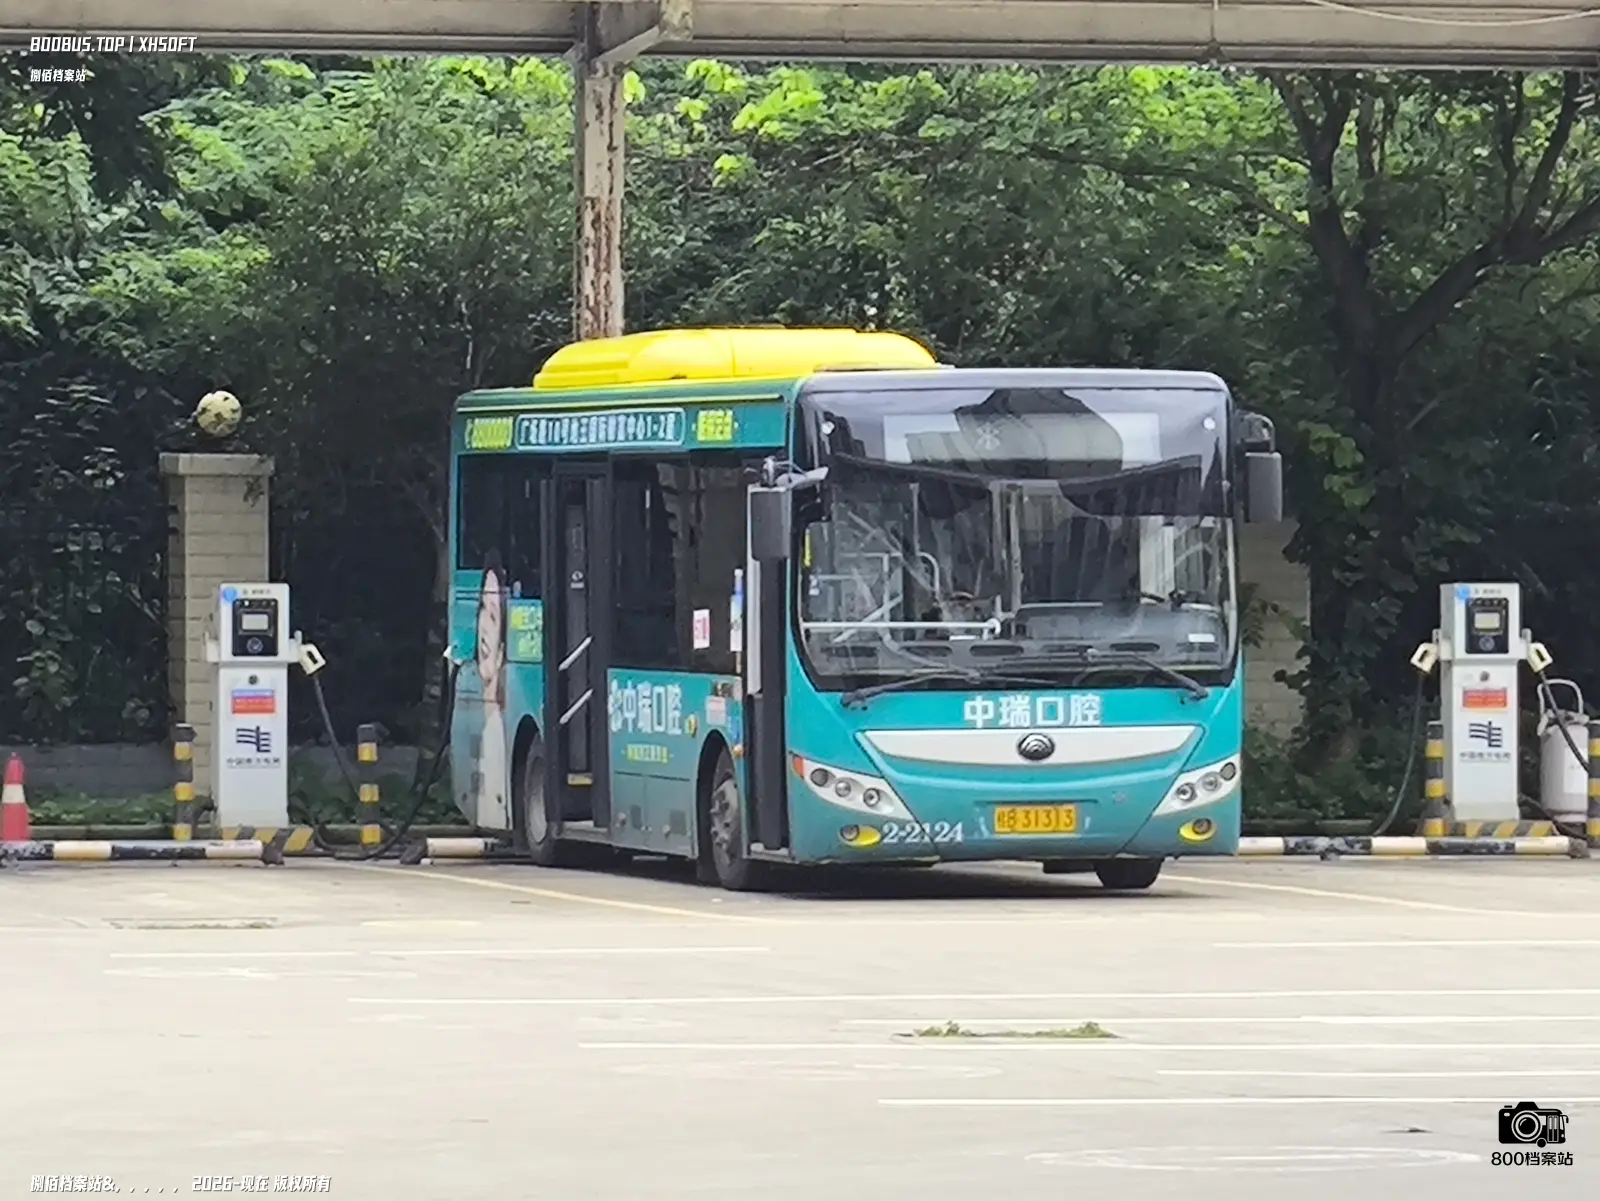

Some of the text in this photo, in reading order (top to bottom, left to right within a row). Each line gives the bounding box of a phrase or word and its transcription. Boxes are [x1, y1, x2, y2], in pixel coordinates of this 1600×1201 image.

[963, 694, 1102, 728] 中瑞口腔
[882, 821, 964, 844] 2-2124
